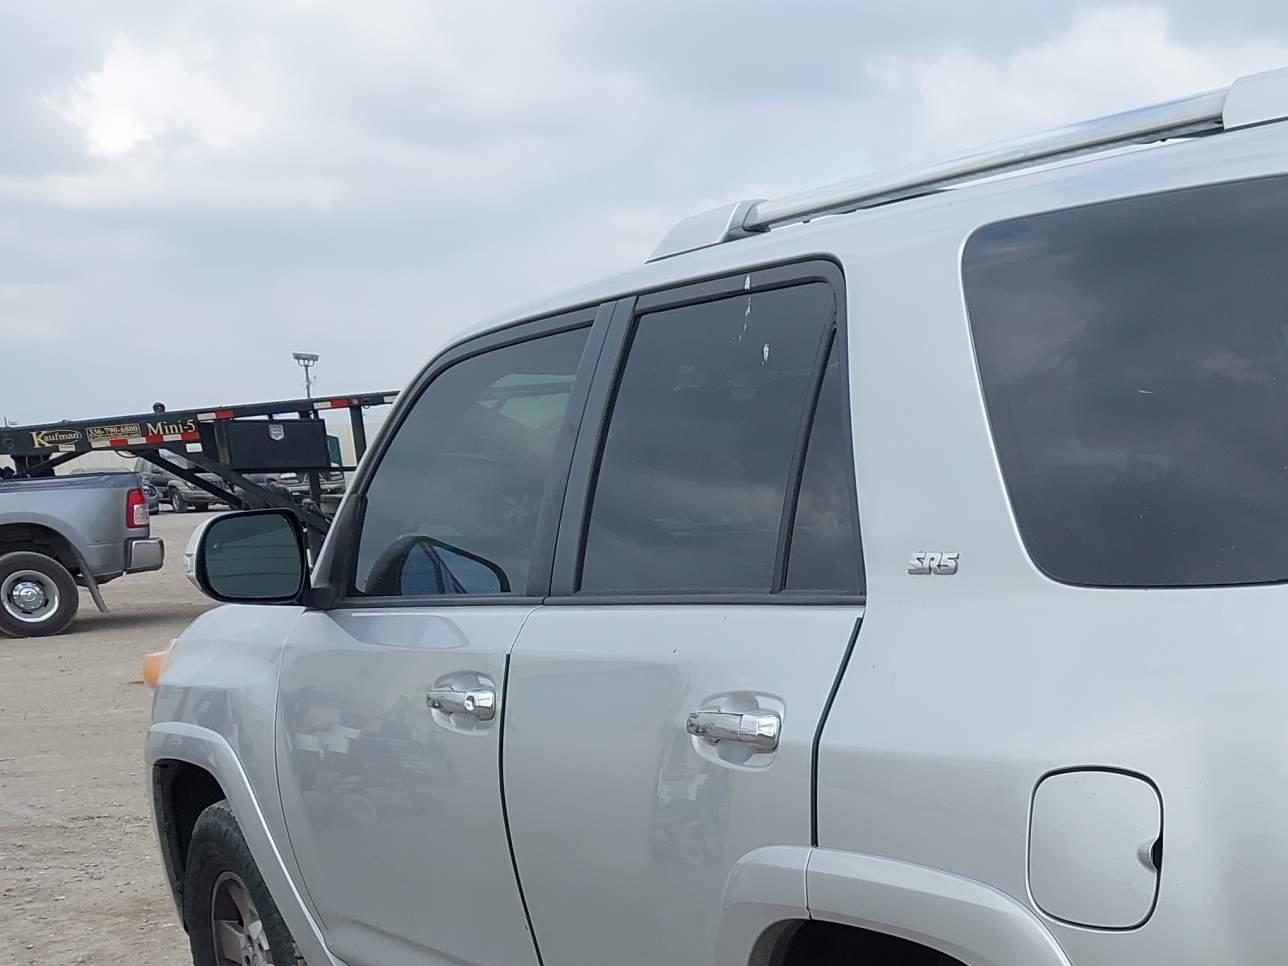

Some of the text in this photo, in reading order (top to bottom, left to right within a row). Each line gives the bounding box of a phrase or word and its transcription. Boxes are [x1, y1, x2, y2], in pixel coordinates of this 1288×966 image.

[146, 418, 196, 436] Mini-5
[30, 430, 80, 448] Kaufman
[908, 551, 959, 575] SR5
